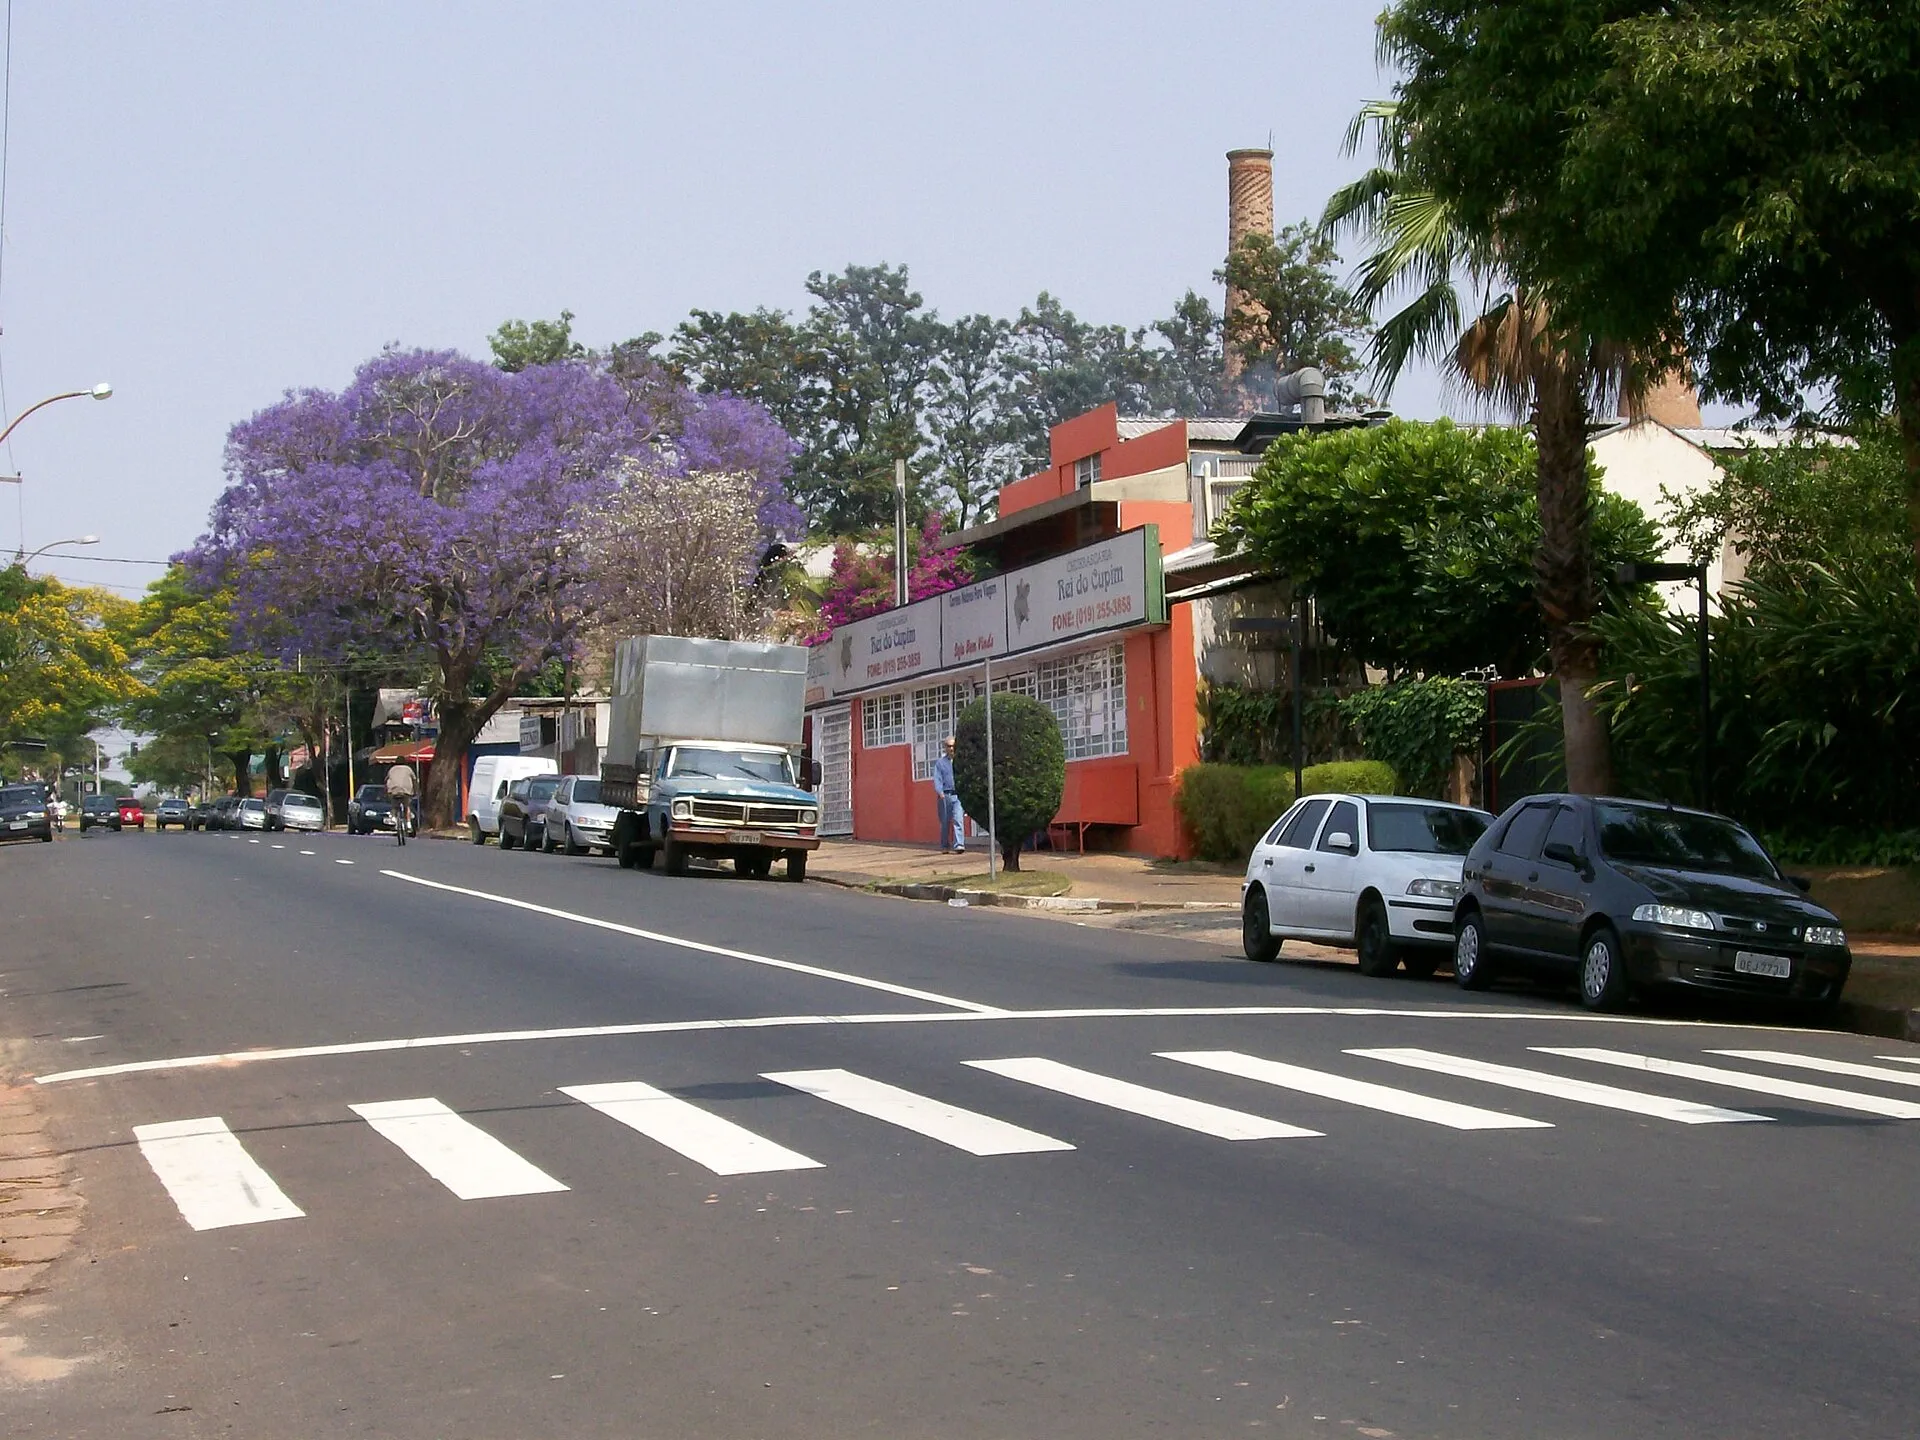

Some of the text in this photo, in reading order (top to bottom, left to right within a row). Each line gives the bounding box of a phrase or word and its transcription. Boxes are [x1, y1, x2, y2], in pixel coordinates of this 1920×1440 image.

[1057, 563, 1124, 601] Rei do Cupim
[1052, 610, 1074, 632] FONE:
[1076, 605, 1095, 629] (019)
[883, 632, 893, 650] do
[893, 627, 916, 650] Cupim
